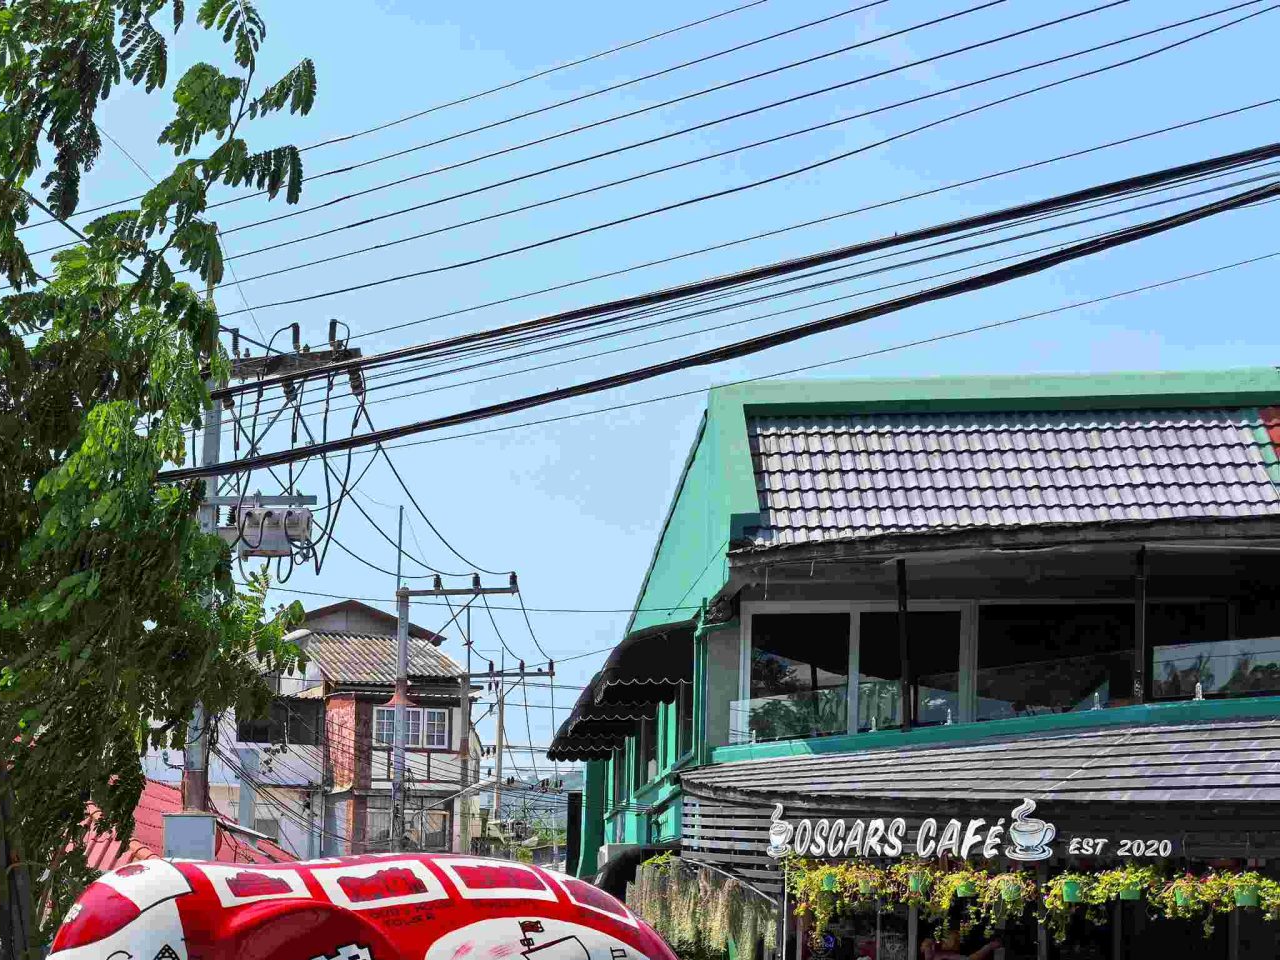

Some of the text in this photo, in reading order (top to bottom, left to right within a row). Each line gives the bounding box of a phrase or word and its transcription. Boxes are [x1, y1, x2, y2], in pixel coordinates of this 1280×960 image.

[794, 817, 1006, 860] OSCARS CAFÉ
[1069, 837, 1172, 857] EST 2020
